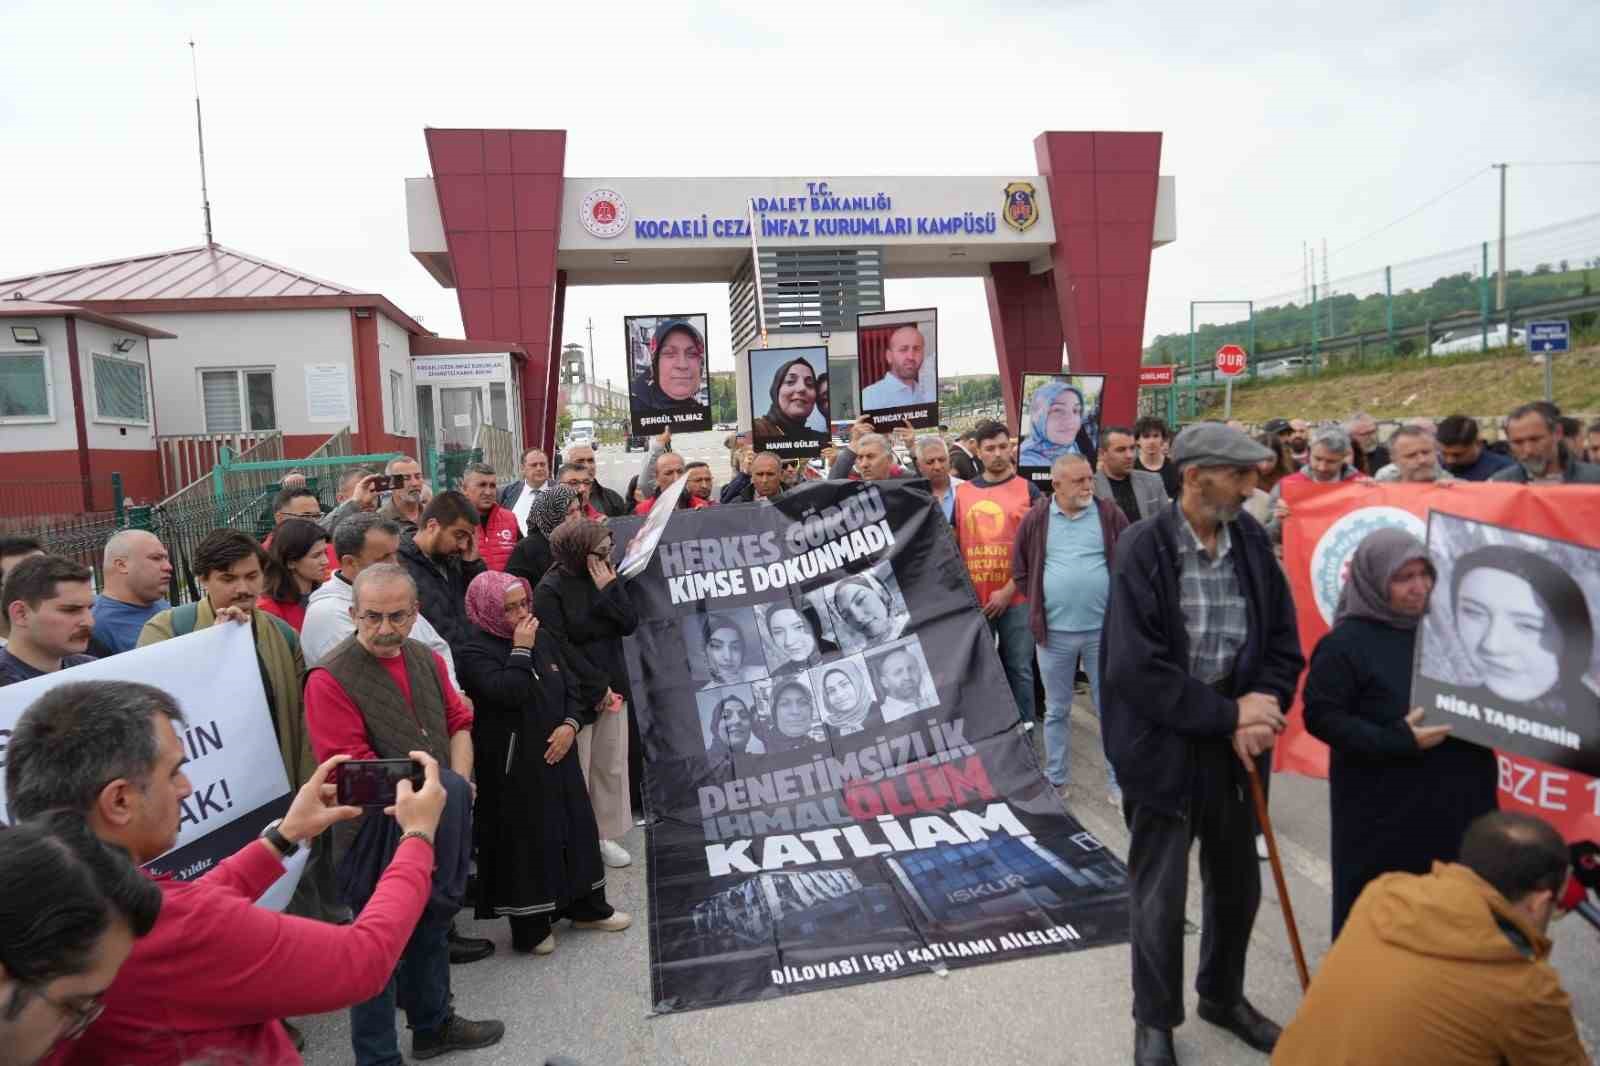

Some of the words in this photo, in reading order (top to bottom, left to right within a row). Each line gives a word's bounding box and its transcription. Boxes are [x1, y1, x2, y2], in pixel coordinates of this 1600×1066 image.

[807, 182, 832, 197] T.C.
[811, 192, 891, 211] BAKANLIĞI
[635, 213, 708, 239] KOCAELİ
[761, 213, 810, 237] İNFAZ
[814, 217, 912, 236] KURUMLARI
[917, 212, 996, 235] KAMPÜSÜ
[1219, 353, 1244, 366] DUR
[640, 414, 672, 426] ŞENGÜL
[673, 412, 704, 423] YILMAZ
[766, 441, 793, 449] HANIM
[659, 530, 781, 577] HERKES
[785, 481, 887, 554] GÖRDÜ
[668, 569, 747, 605] KİMSE
[750, 519, 896, 592] DOKUNMADI
[1435, 693, 1481, 720] NİSA
[1482, 706, 1581, 751] TAŞDEMİR
[697, 718, 977, 819] DENETİMSİZLİK
[1498, 754, 1569, 812] BZE
[704, 801, 1033, 877] KATLİAM
